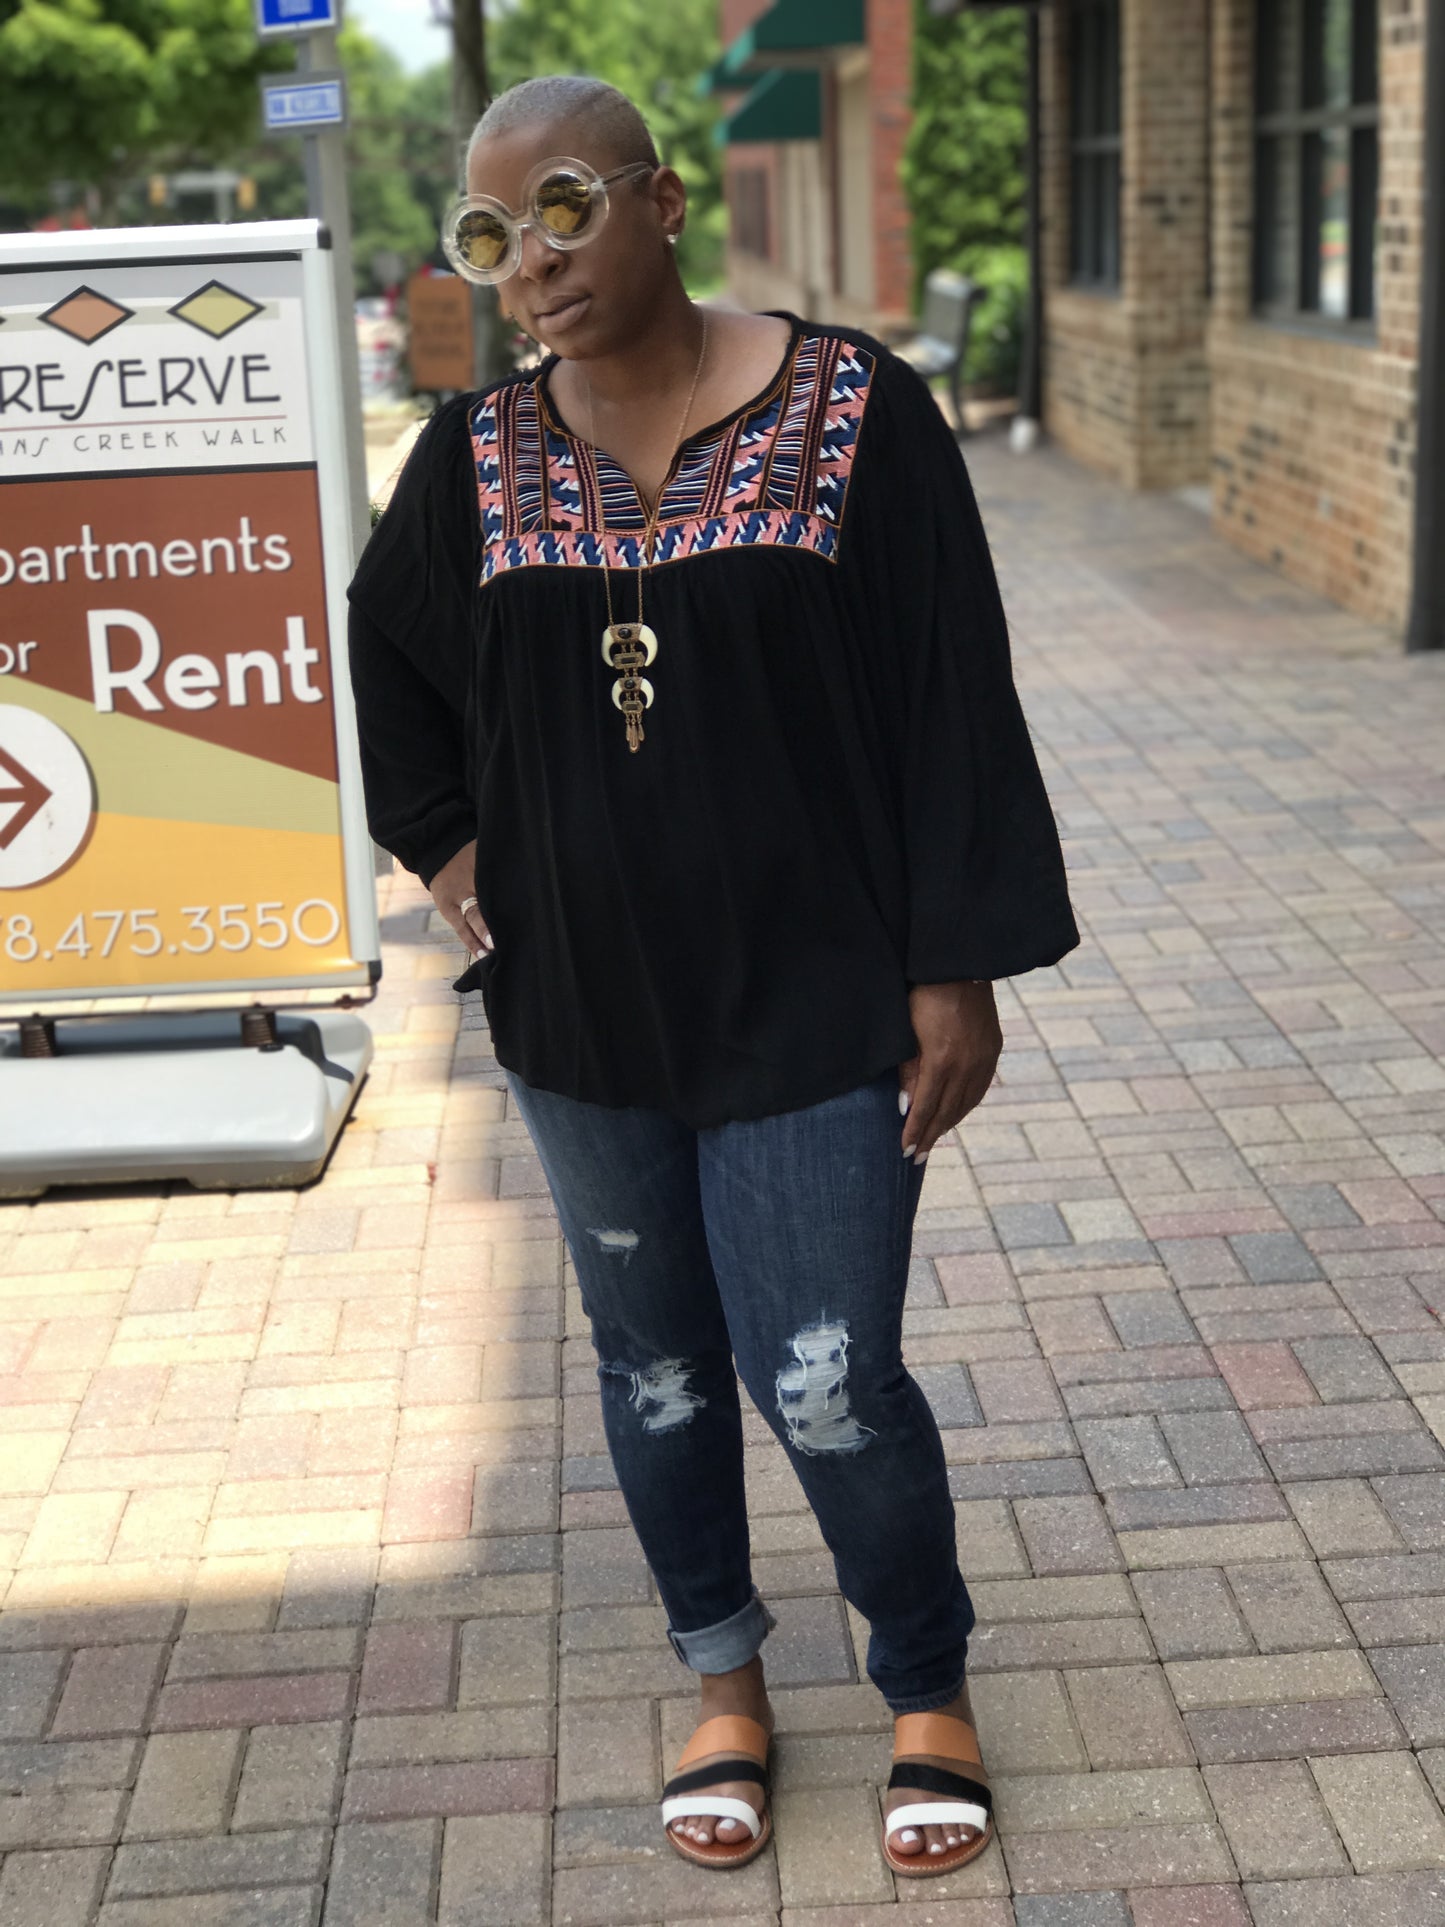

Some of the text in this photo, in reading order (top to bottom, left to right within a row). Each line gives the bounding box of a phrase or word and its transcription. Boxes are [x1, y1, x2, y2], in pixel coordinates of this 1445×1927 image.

[0, 354, 281, 421] RESERVE
[0, 426, 287, 457] NS CREEK WALK
[87, 608, 323, 712] Rent
[0, 899, 340, 961] 8.475.3550
